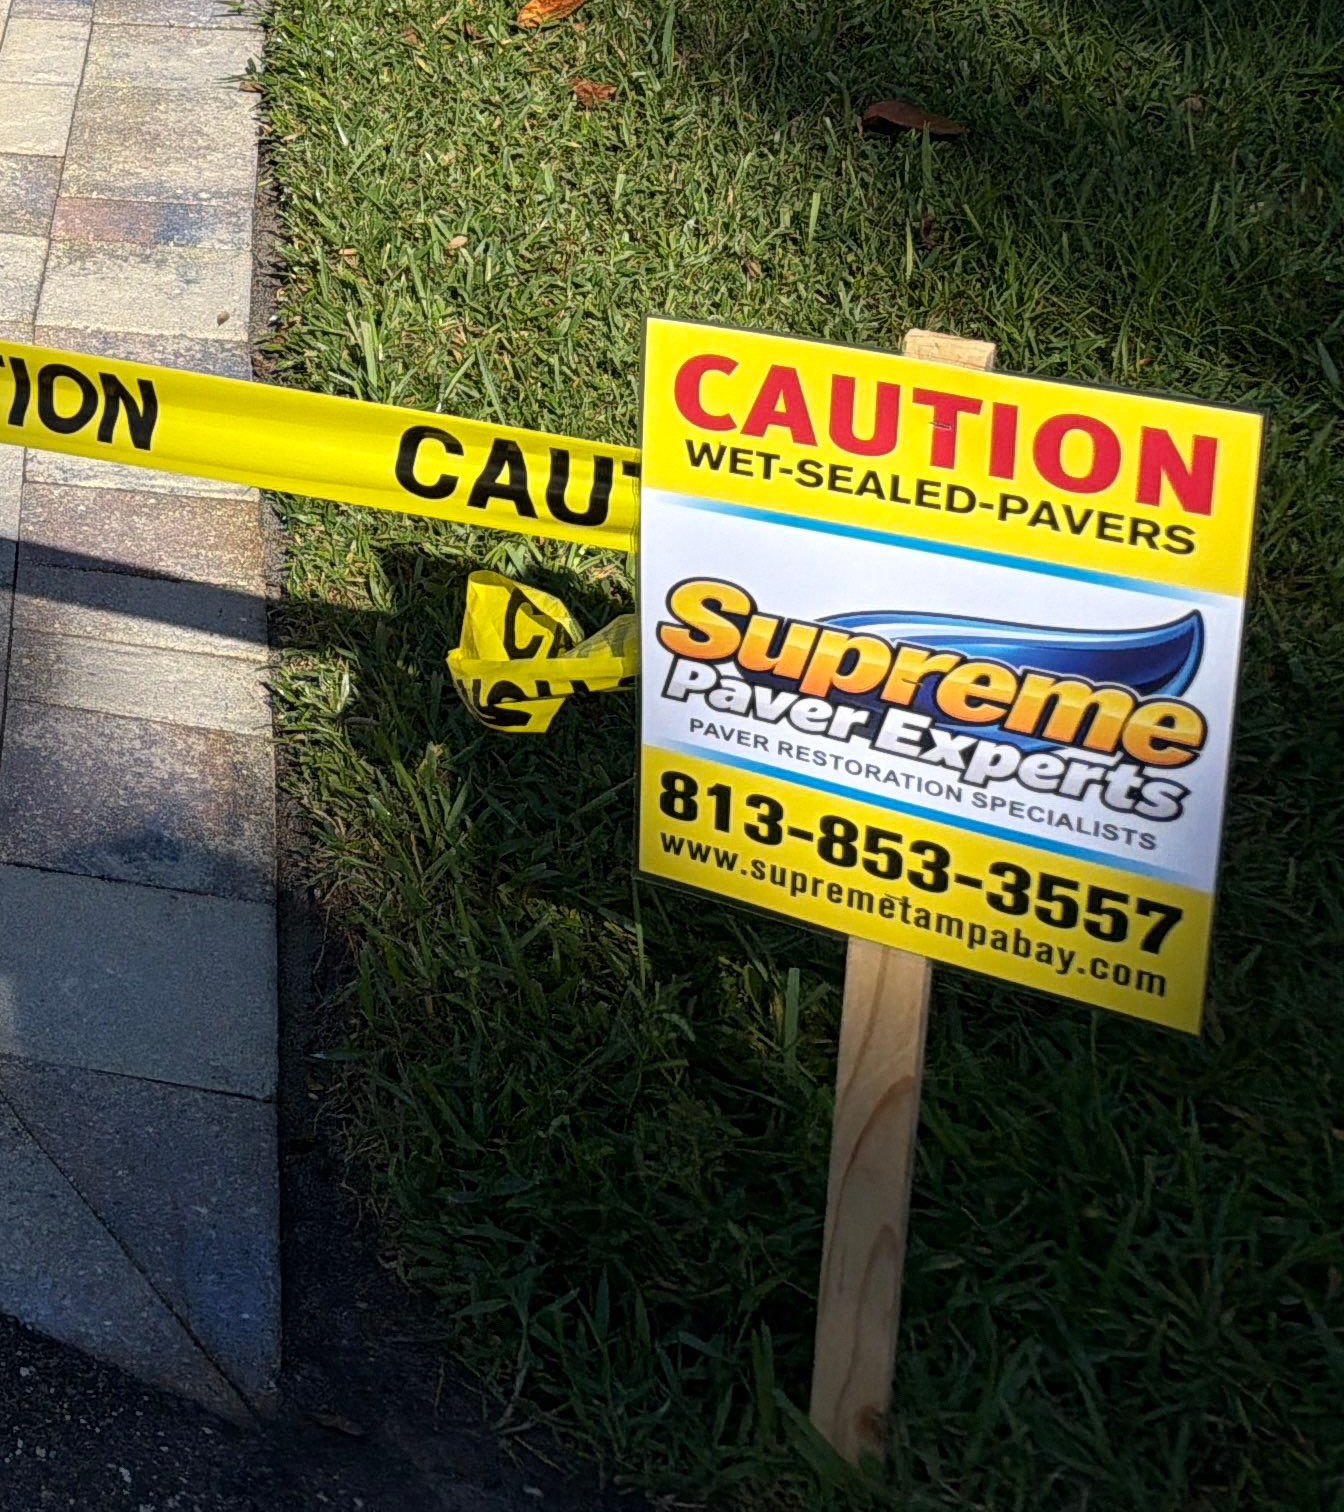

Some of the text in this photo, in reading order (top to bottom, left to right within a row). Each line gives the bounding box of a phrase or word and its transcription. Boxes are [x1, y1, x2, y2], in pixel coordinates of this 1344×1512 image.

[674, 354, 1218, 517] CAUTION
[685, 439, 1197, 556] WET-SEALED-PAVERS
[656, 577, 1208, 769] Supreme
[661, 658, 873, 745] Paver
[871, 707, 1194, 822] Experts
[659, 769, 1183, 956] 813-853-3557
[689, 717, 1157, 852] PAVER RESTORATION SPECIALISTS
[660, 830, 1168, 999] www.supremetampabay.com
